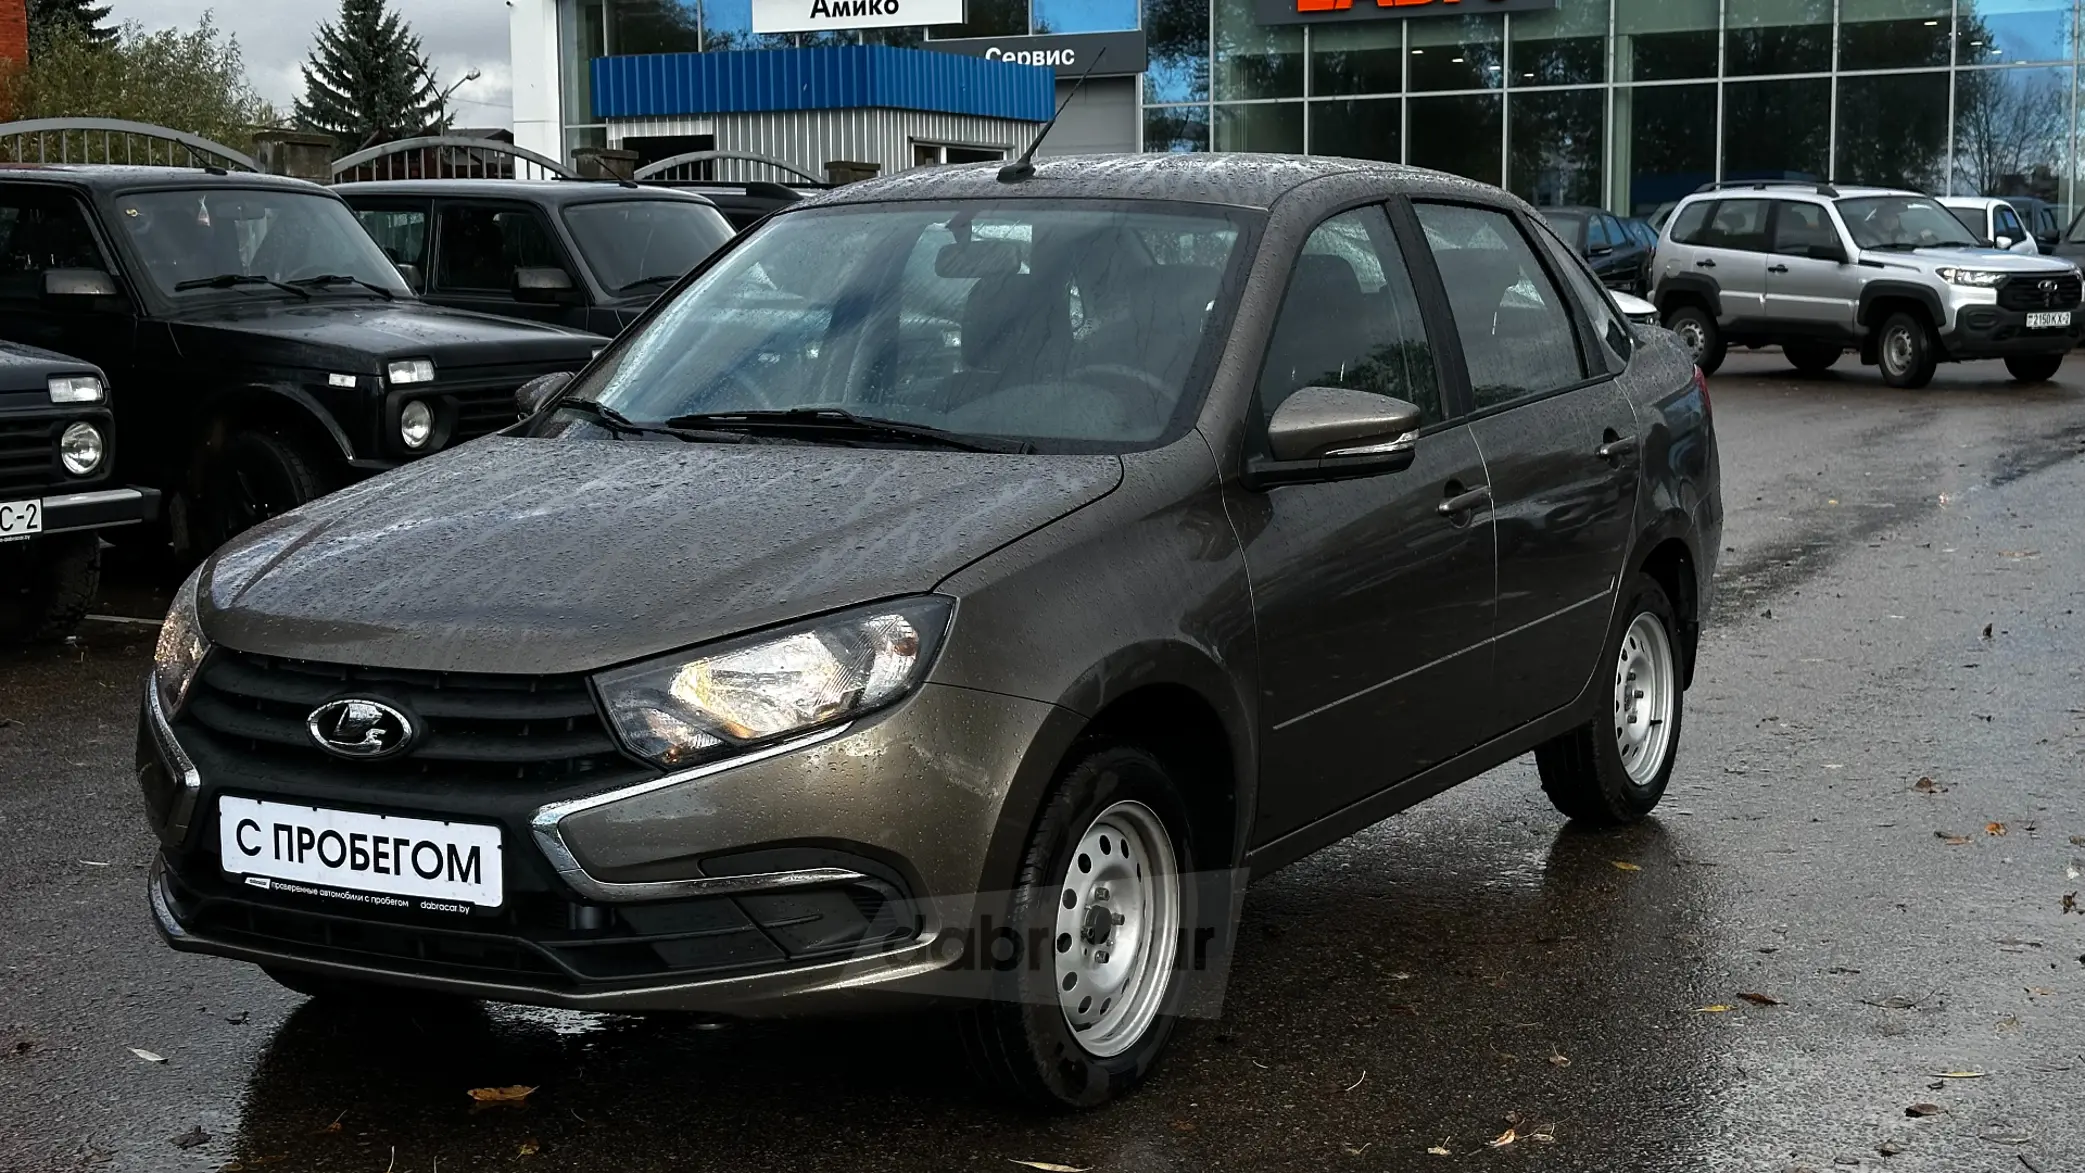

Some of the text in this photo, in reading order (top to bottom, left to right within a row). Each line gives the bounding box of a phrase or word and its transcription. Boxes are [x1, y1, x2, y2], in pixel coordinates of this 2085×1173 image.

[810, 0, 899, 18] Амико
[985, 47, 1075, 66] Сервис
[236, 818, 482, 885] С ПРОБЕГОМ
[271, 881, 318, 896] проверенные
[319, 889, 363, 902] автомобили
[371, 896, 409, 908] пробегом
[420, 900, 470, 915] dabracar.by
